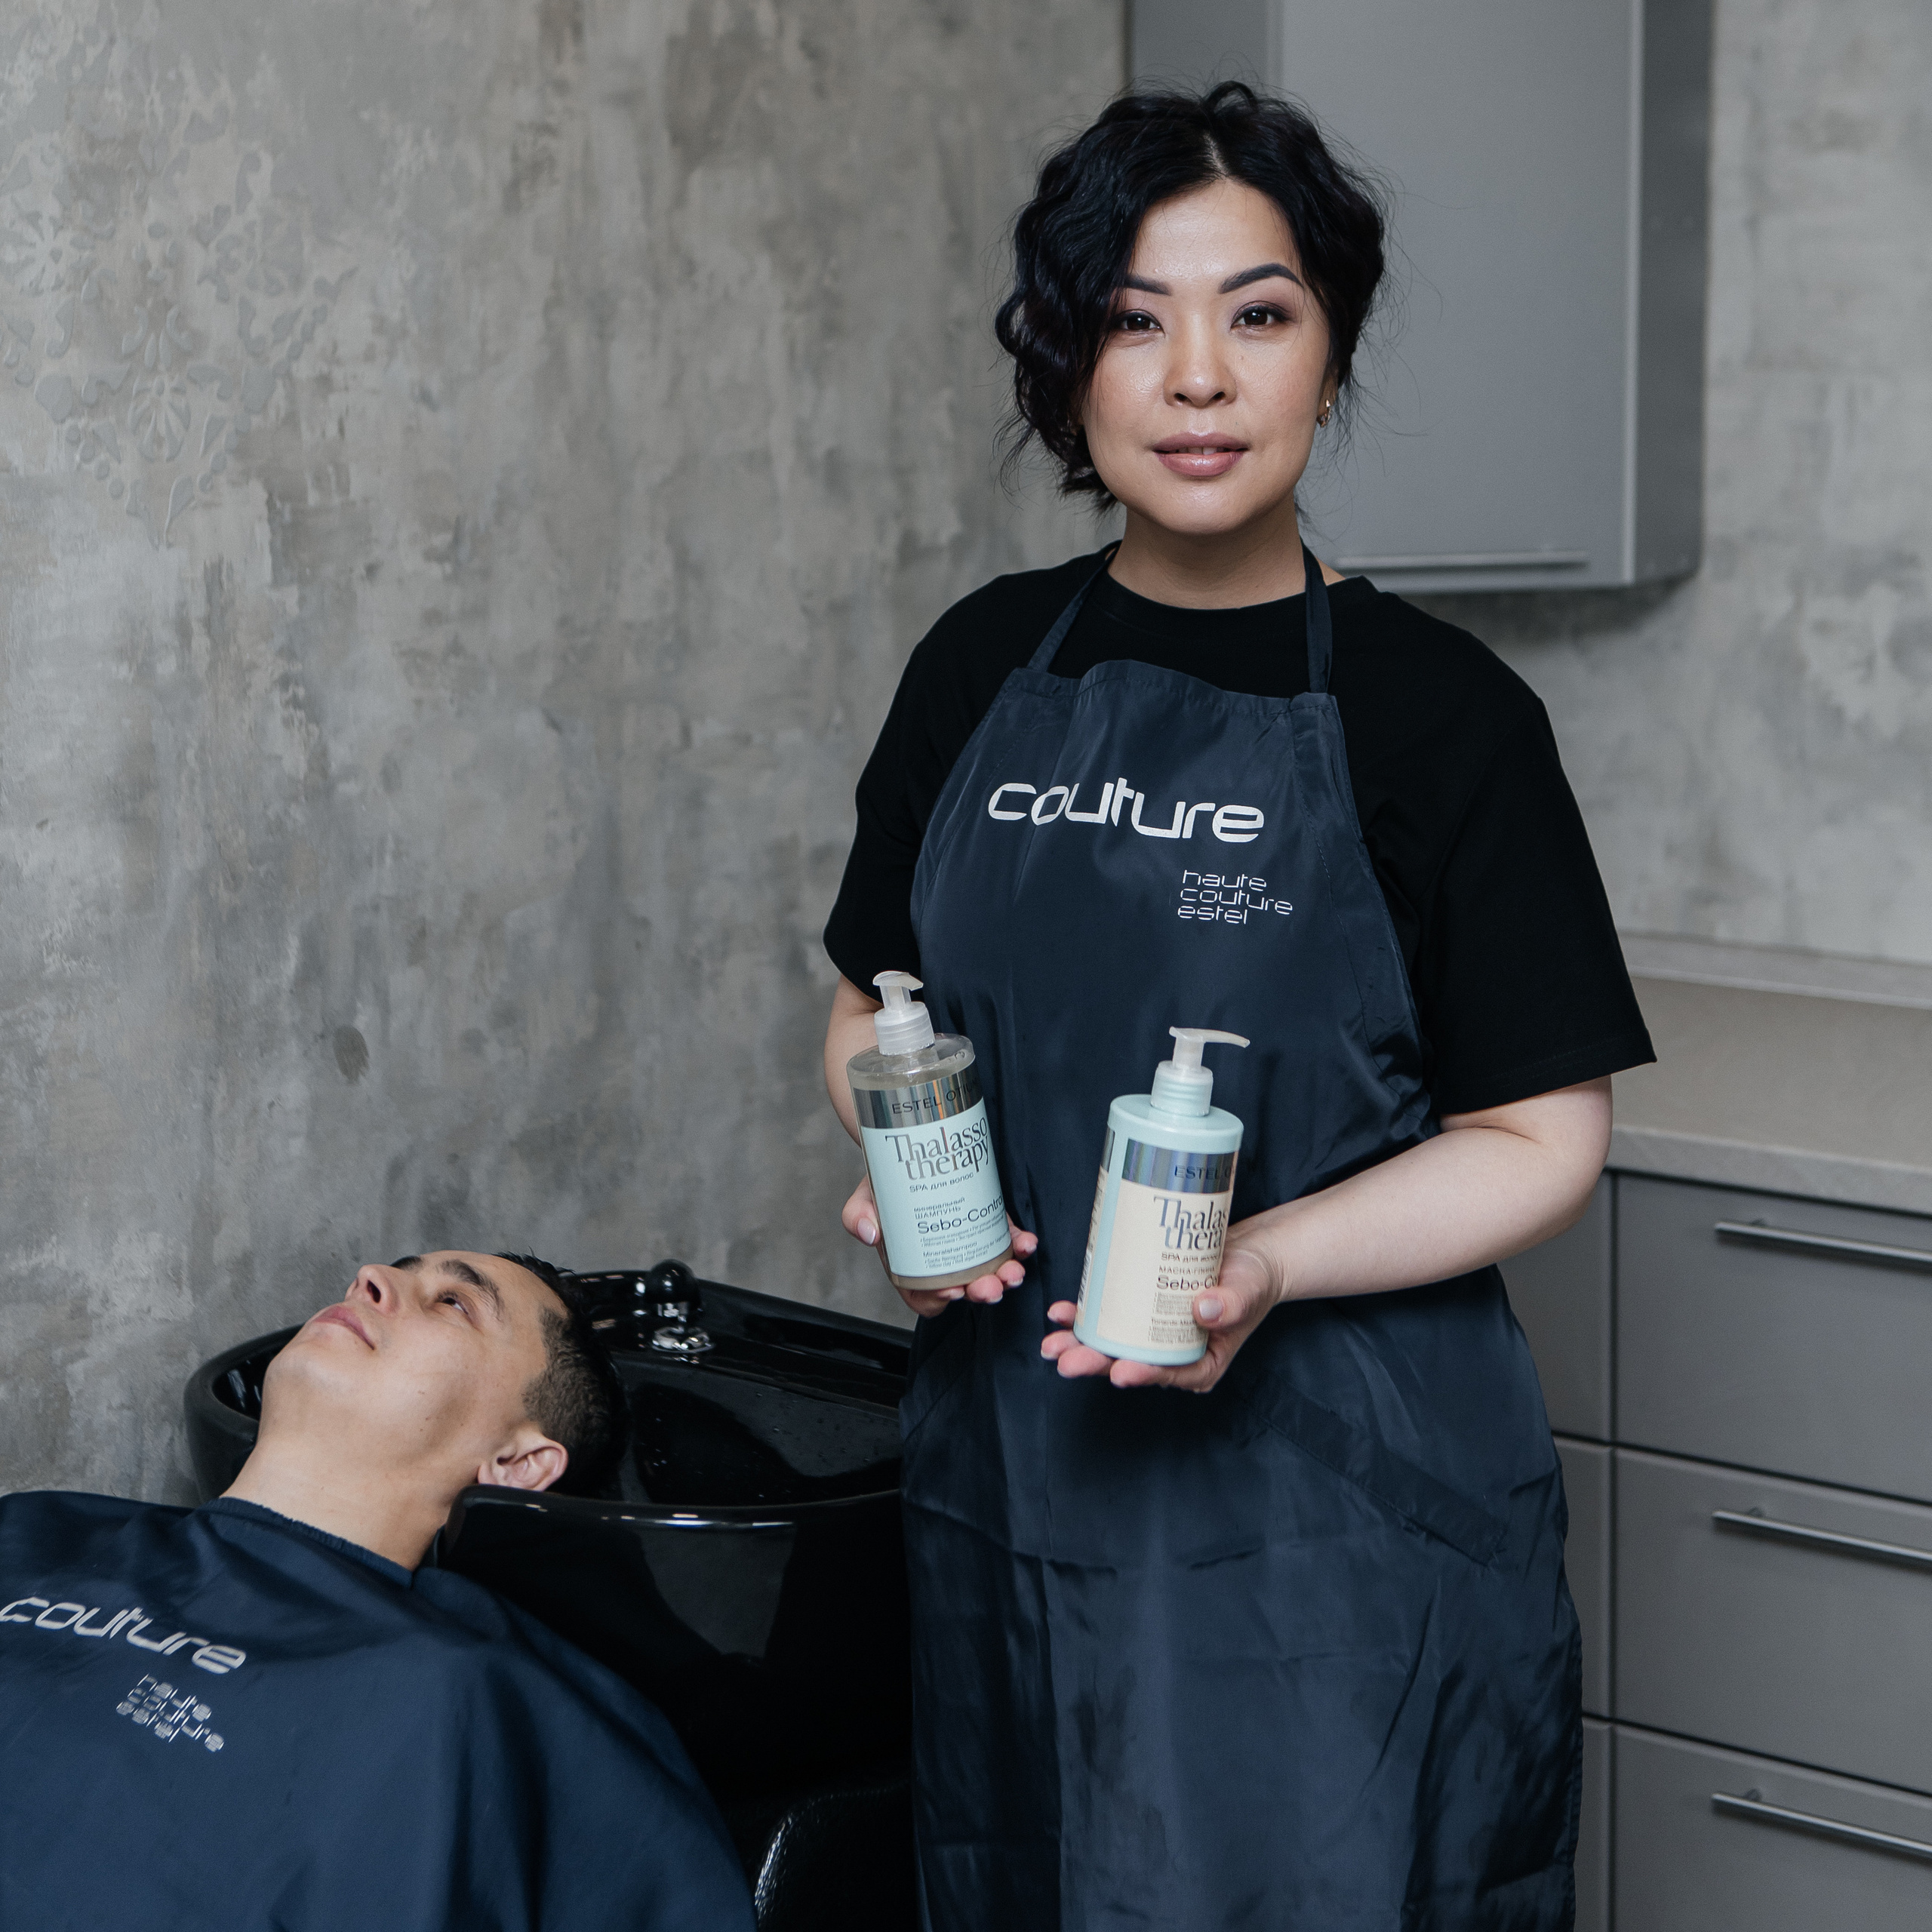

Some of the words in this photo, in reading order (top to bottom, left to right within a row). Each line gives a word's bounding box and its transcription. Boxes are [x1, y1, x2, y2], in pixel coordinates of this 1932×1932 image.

[988, 777, 1264, 843] couture
[1182, 869, 1267, 891] haute
[1180, 888, 1294, 915] couture
[1177, 905, 1248, 925] estel
[892, 1096, 942, 1114] ESTEL
[884, 1117, 987, 1163] Thalasso
[905, 1135, 989, 1180] therapy
[909, 1184, 928, 1193] SPA
[931, 1180, 947, 1191] для
[949, 1172, 974, 1186] волос
[915, 1206, 961, 1220] ШАМПУНЬ
[0, 1597, 247, 1674] couture
